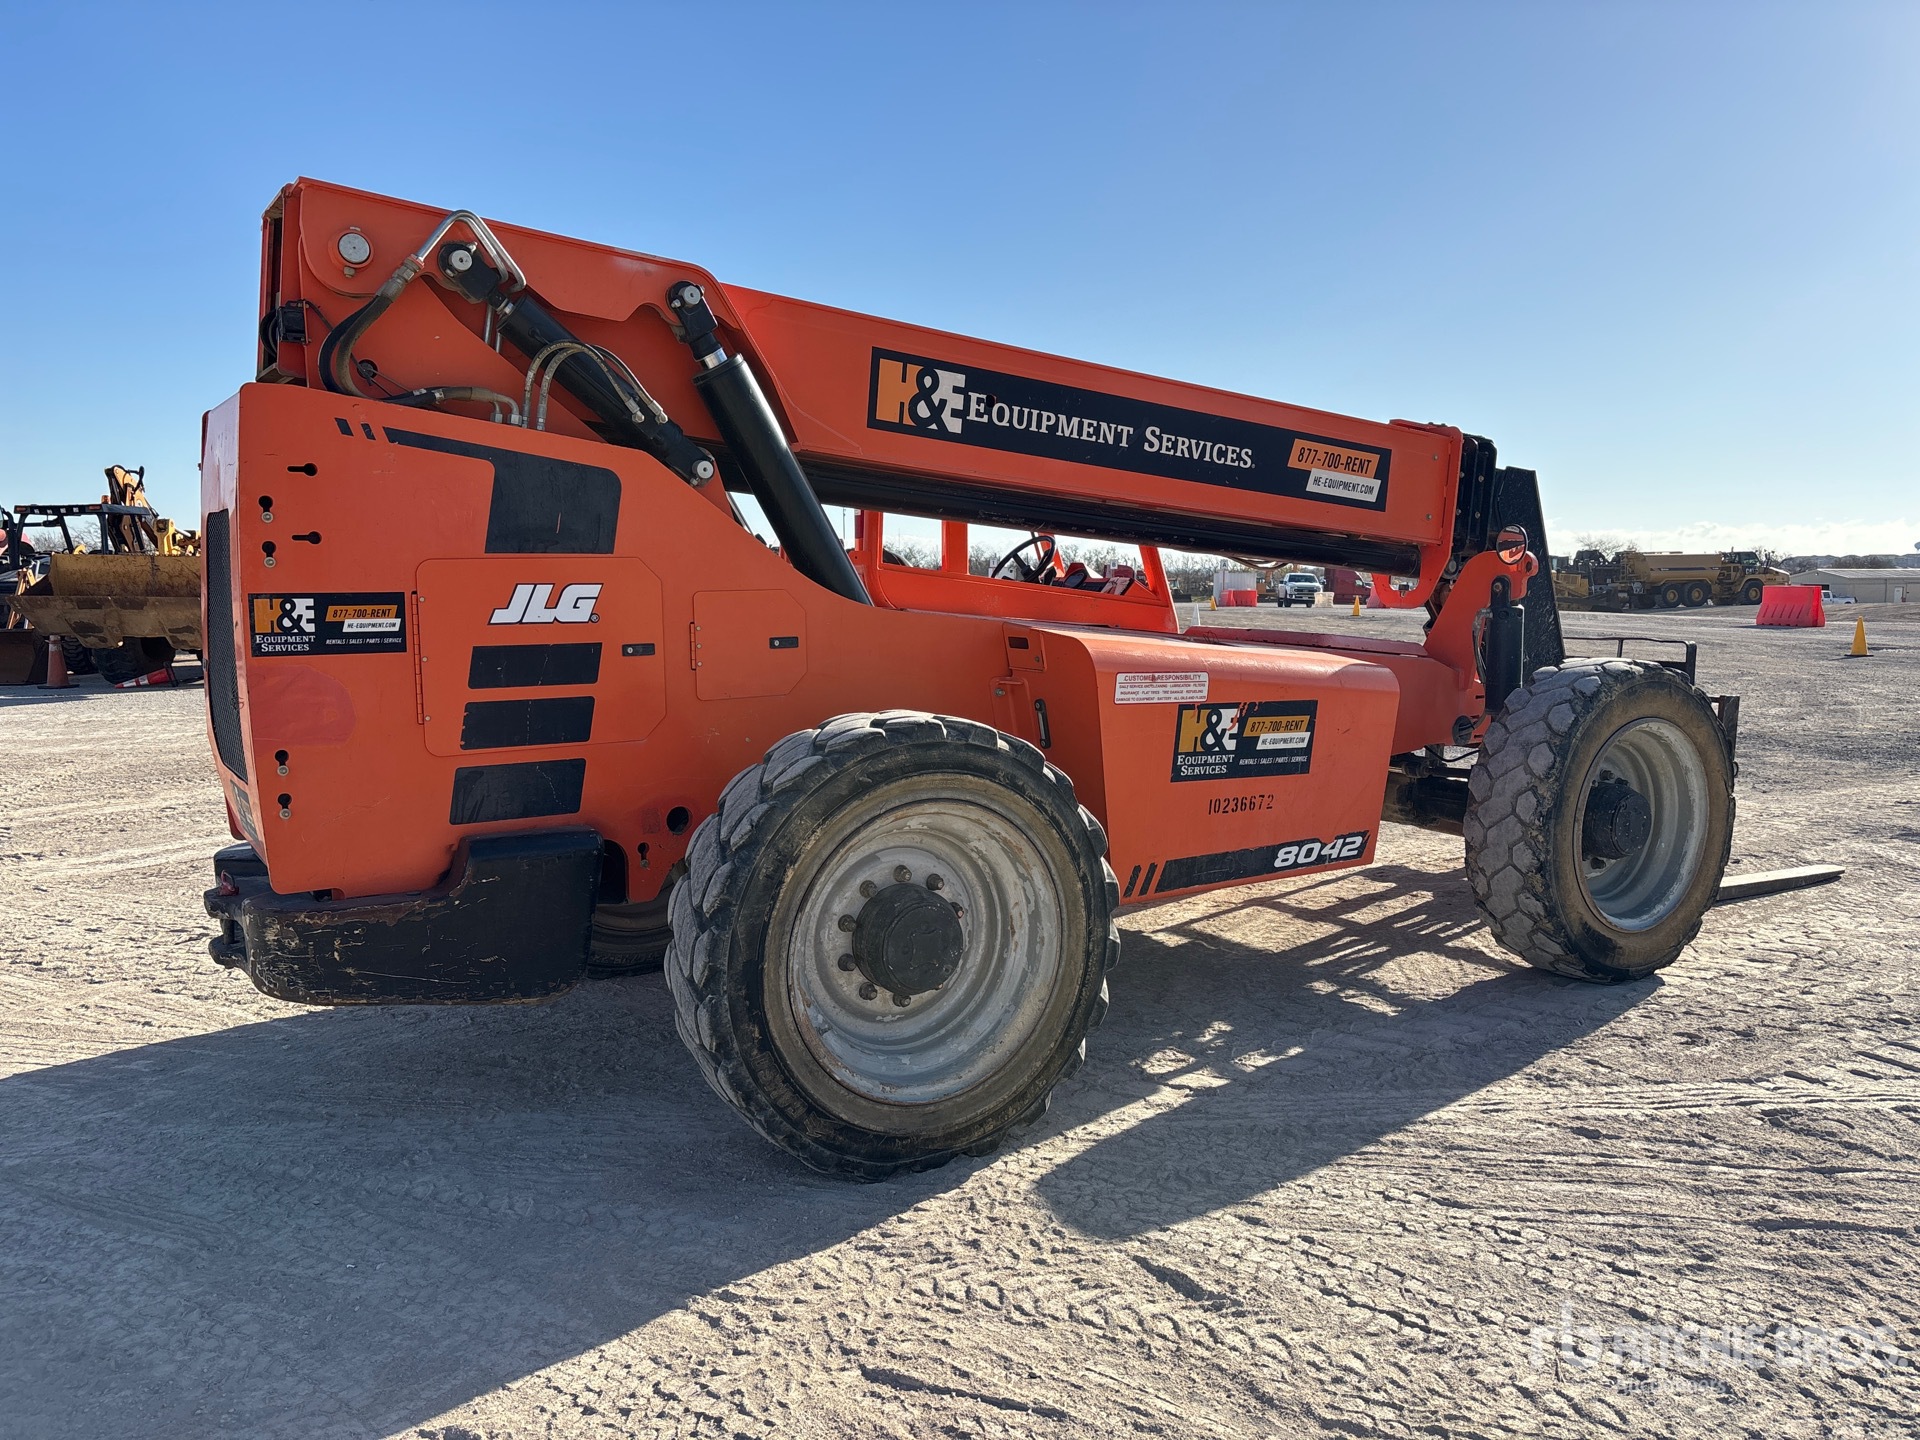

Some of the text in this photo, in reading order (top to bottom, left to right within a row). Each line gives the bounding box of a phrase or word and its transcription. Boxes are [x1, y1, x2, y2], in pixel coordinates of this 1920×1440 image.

[874, 357, 966, 434] H&E
[966, 391, 1253, 469] EQUIPMENT SERVICES
[1297, 445, 1372, 475] 877-700-RENT
[1312, 475, 1375, 496] HE-EQUIPMENT.COM
[488, 583, 603, 625] JLG
[253, 598, 316, 633] H&E
[332, 608, 392, 618] 877-700-RENT
[347, 621, 397, 629] HE-EQUIPMENT.COM
[255, 635, 316, 644] EQUIPMENT
[261, 643, 310, 652] SERVICES
[1124, 674, 1156, 682] CUSTOMER
[1178, 708, 1240, 752] H&E
[1250, 720, 1305, 733] 877-700-RENT
[1260, 736, 1307, 746] HE-EQUIPMENT.COM
[1176, 754, 1235, 766] EQUIPMENT
[1259, 757, 1273, 765] SALES
[1275, 757, 1289, 765] PARTS
[1290, 755, 1308, 763] SERVICE
[1180, 765, 1228, 776] SERVICES
[1208, 793, 1275, 815] 10236672
[1273, 835, 1363, 868] 8042
